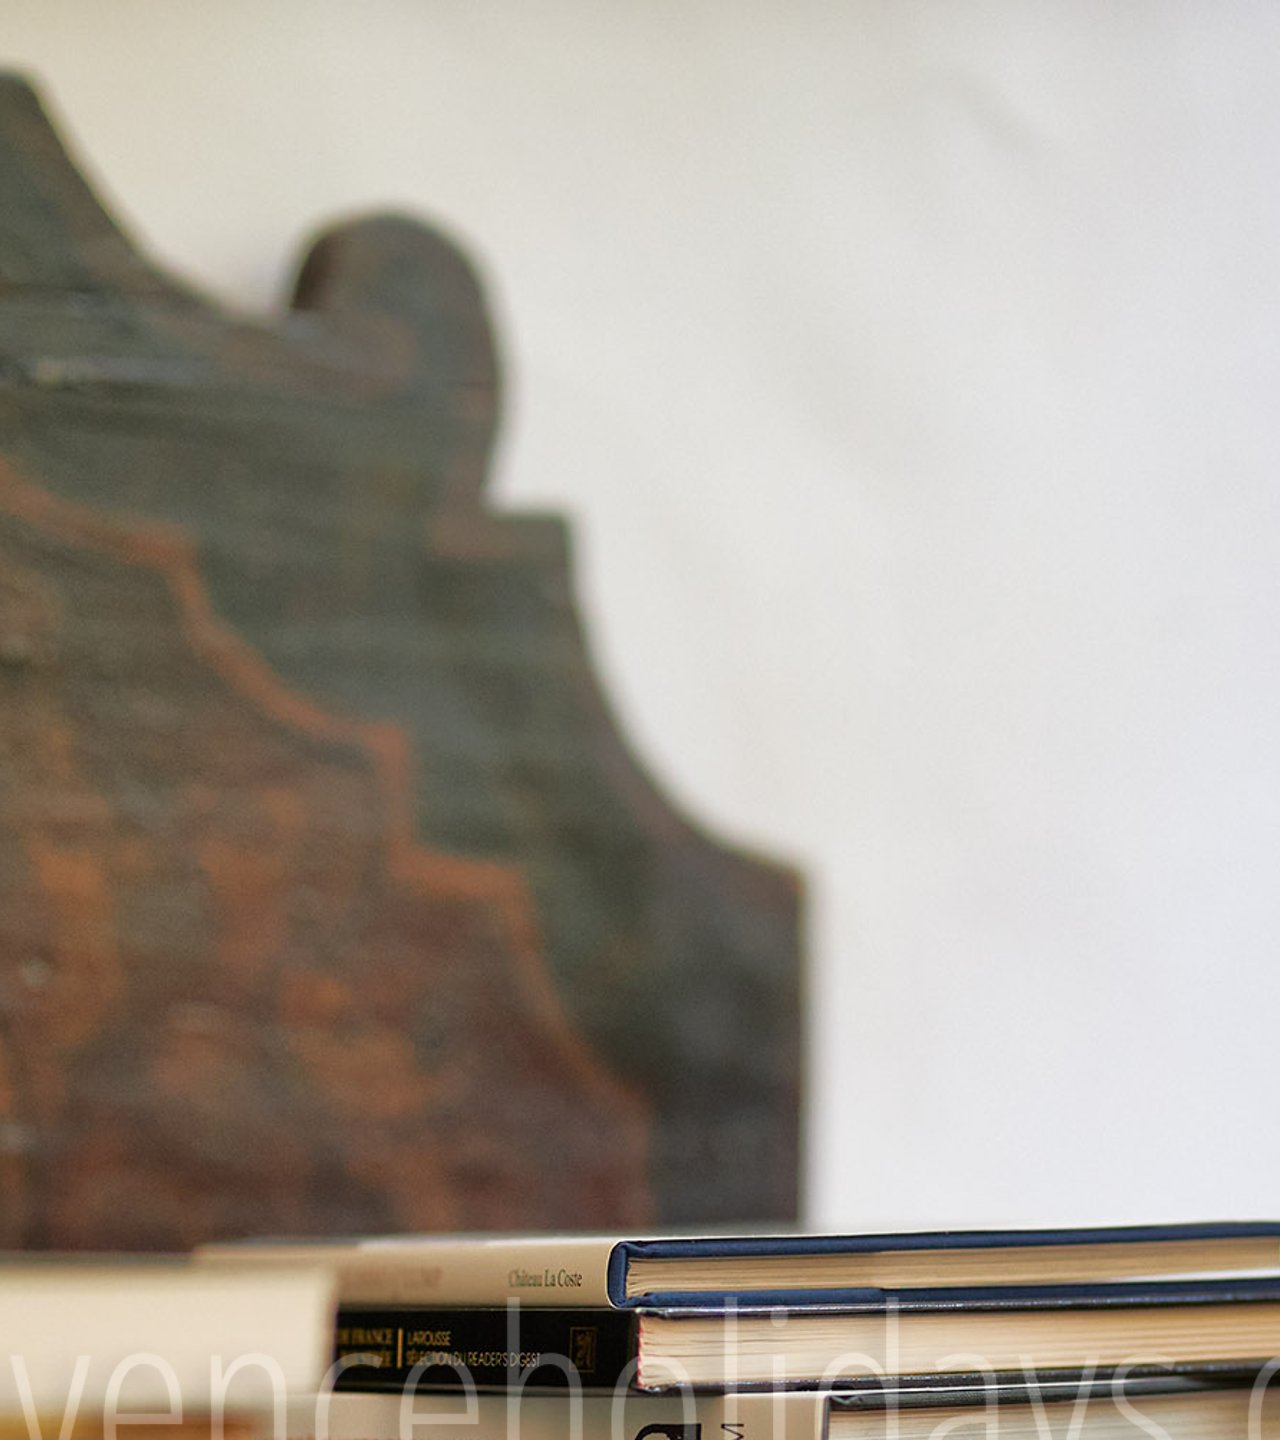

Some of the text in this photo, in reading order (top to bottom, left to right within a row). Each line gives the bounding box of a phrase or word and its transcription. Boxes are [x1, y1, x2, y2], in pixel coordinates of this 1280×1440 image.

[544, 1270, 556, 1288] La
[557, 1268, 583, 1288] Coste
[406, 1330, 451, 1346] LAROUSSE
[509, 1353, 541, 1369] DIGEST
